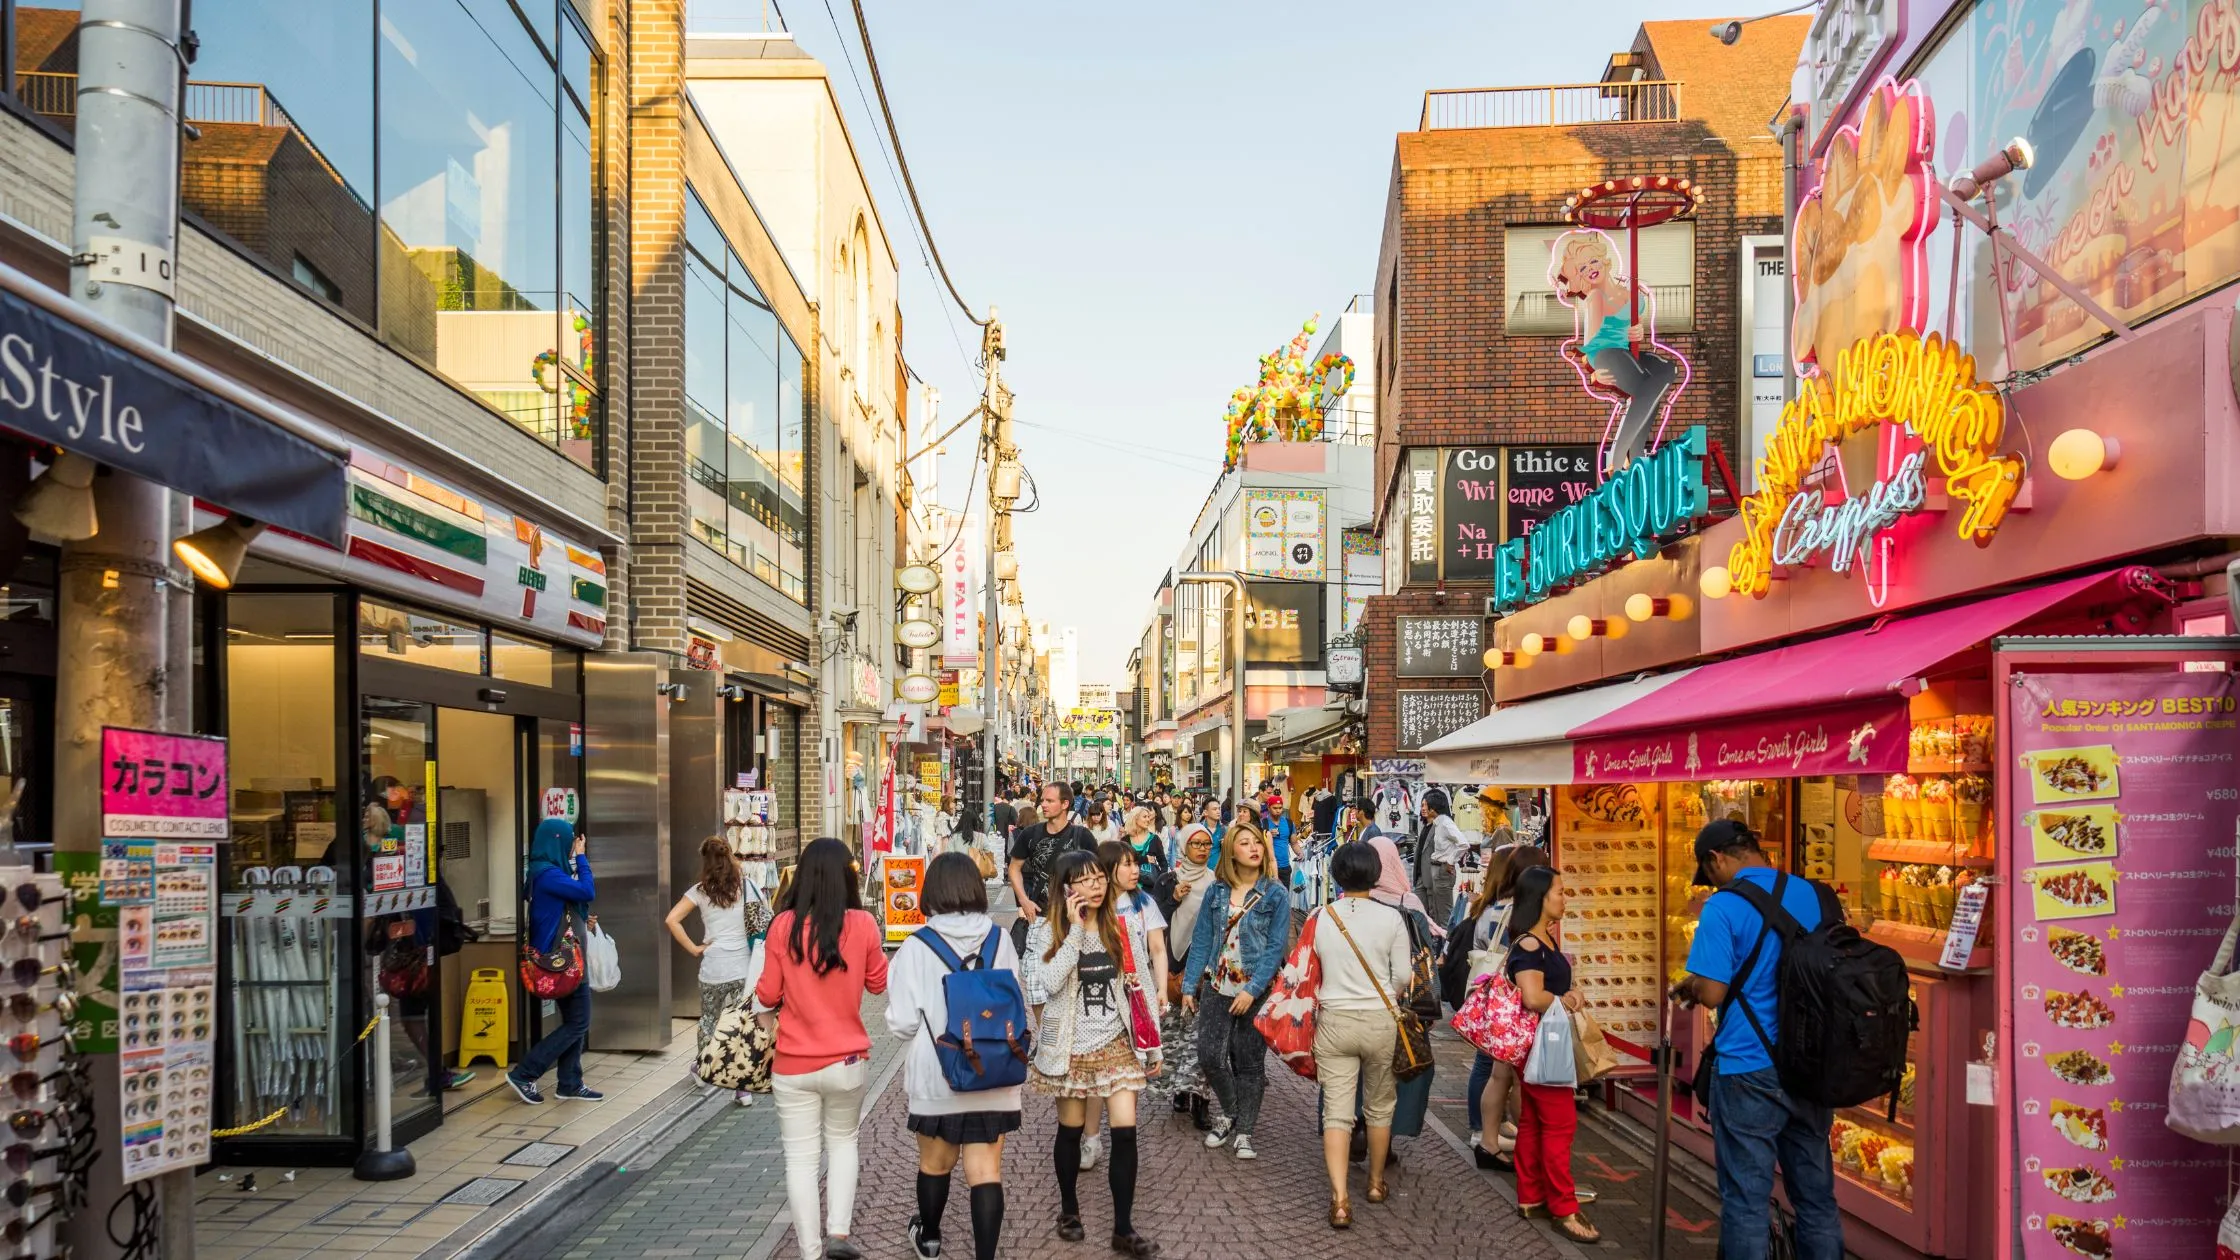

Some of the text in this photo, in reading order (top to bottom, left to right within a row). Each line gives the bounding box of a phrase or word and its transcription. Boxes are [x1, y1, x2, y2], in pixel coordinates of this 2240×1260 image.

[1758, 260, 1784, 276] THE
[0, 333, 146, 454] Style
[1456, 450, 1496, 471] Go
[1514, 450, 1569, 473] thic
[1573, 457, 1590, 472] &
[1457, 479, 1495, 502] Vivi
[1508, 486, 1554, 507] enne
[1410, 469, 1435, 561] 買取委託
[1526, 425, 1710, 604] BURLESQUE
[1457, 523, 1488, 540] Na
[2042, 697, 2236, 717] 人気ランキング BEST10
[2041, 722, 2083, 733] Popular
[2127, 720, 2203, 731] SANTAMONICA
[1792, 725, 1829, 770] Girls
[112, 755, 220, 799] カラコン
[2206, 788, 2239, 801] ¥580
